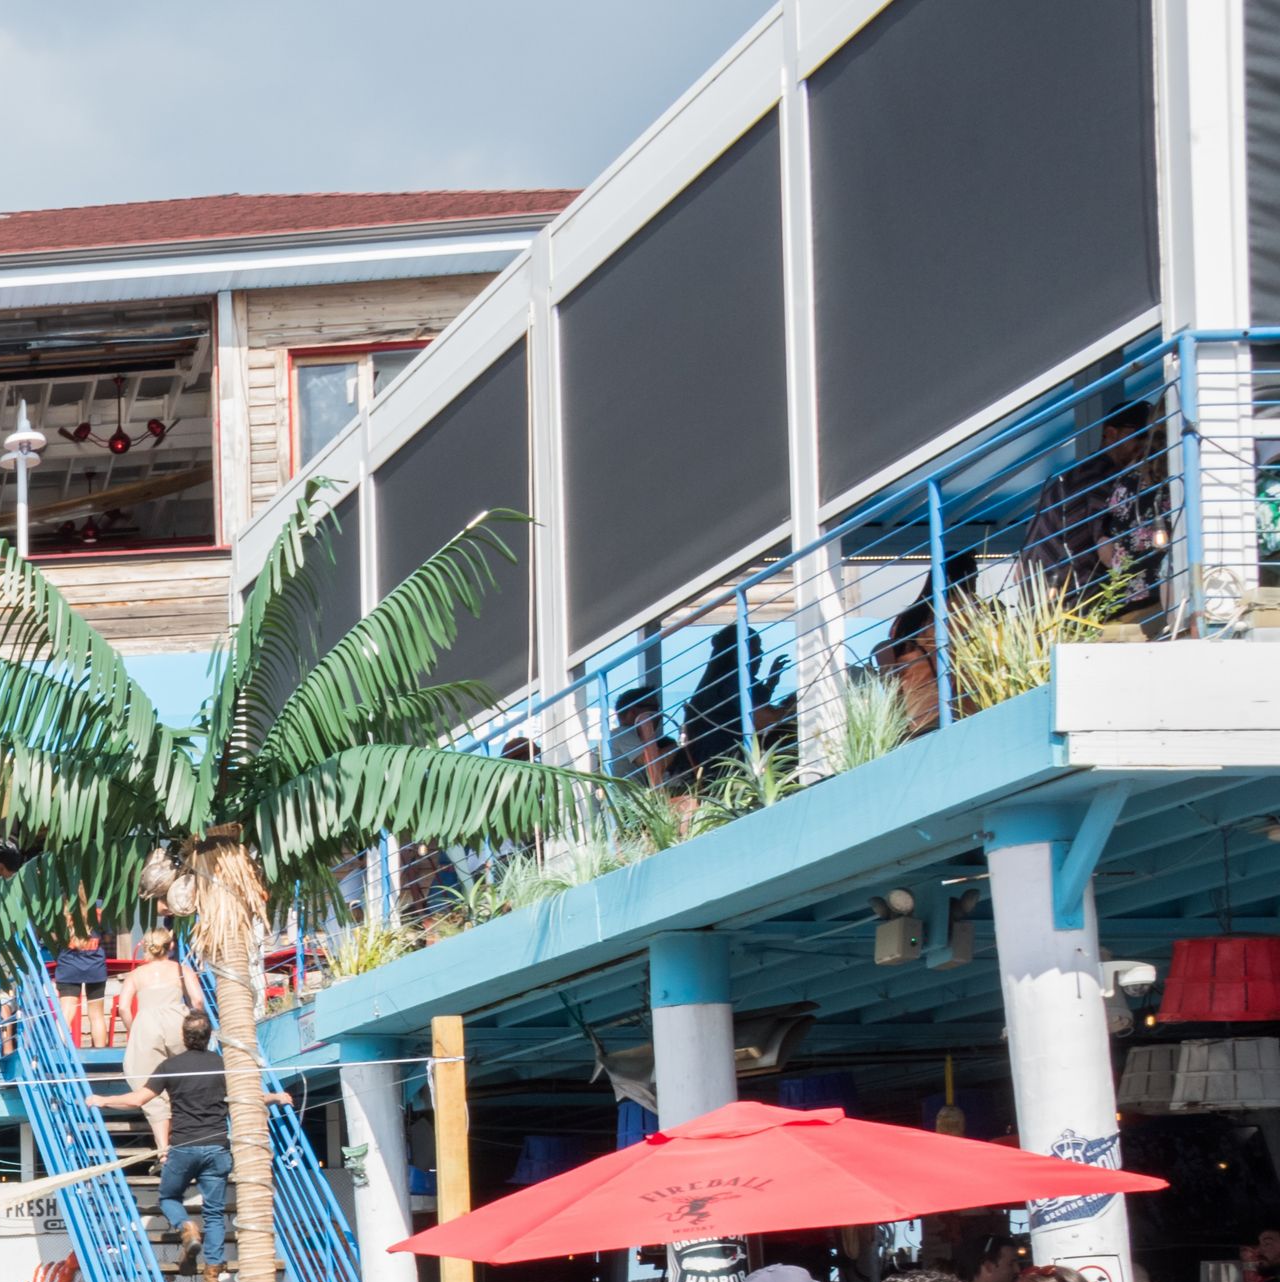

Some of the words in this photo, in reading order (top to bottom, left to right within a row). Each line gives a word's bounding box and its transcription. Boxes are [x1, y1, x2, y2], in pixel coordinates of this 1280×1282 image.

[639, 1176, 774, 1203] FIREBALL
[6, 1198, 56, 1218] FRESH
[1043, 1198, 1085, 1222] BREWING
